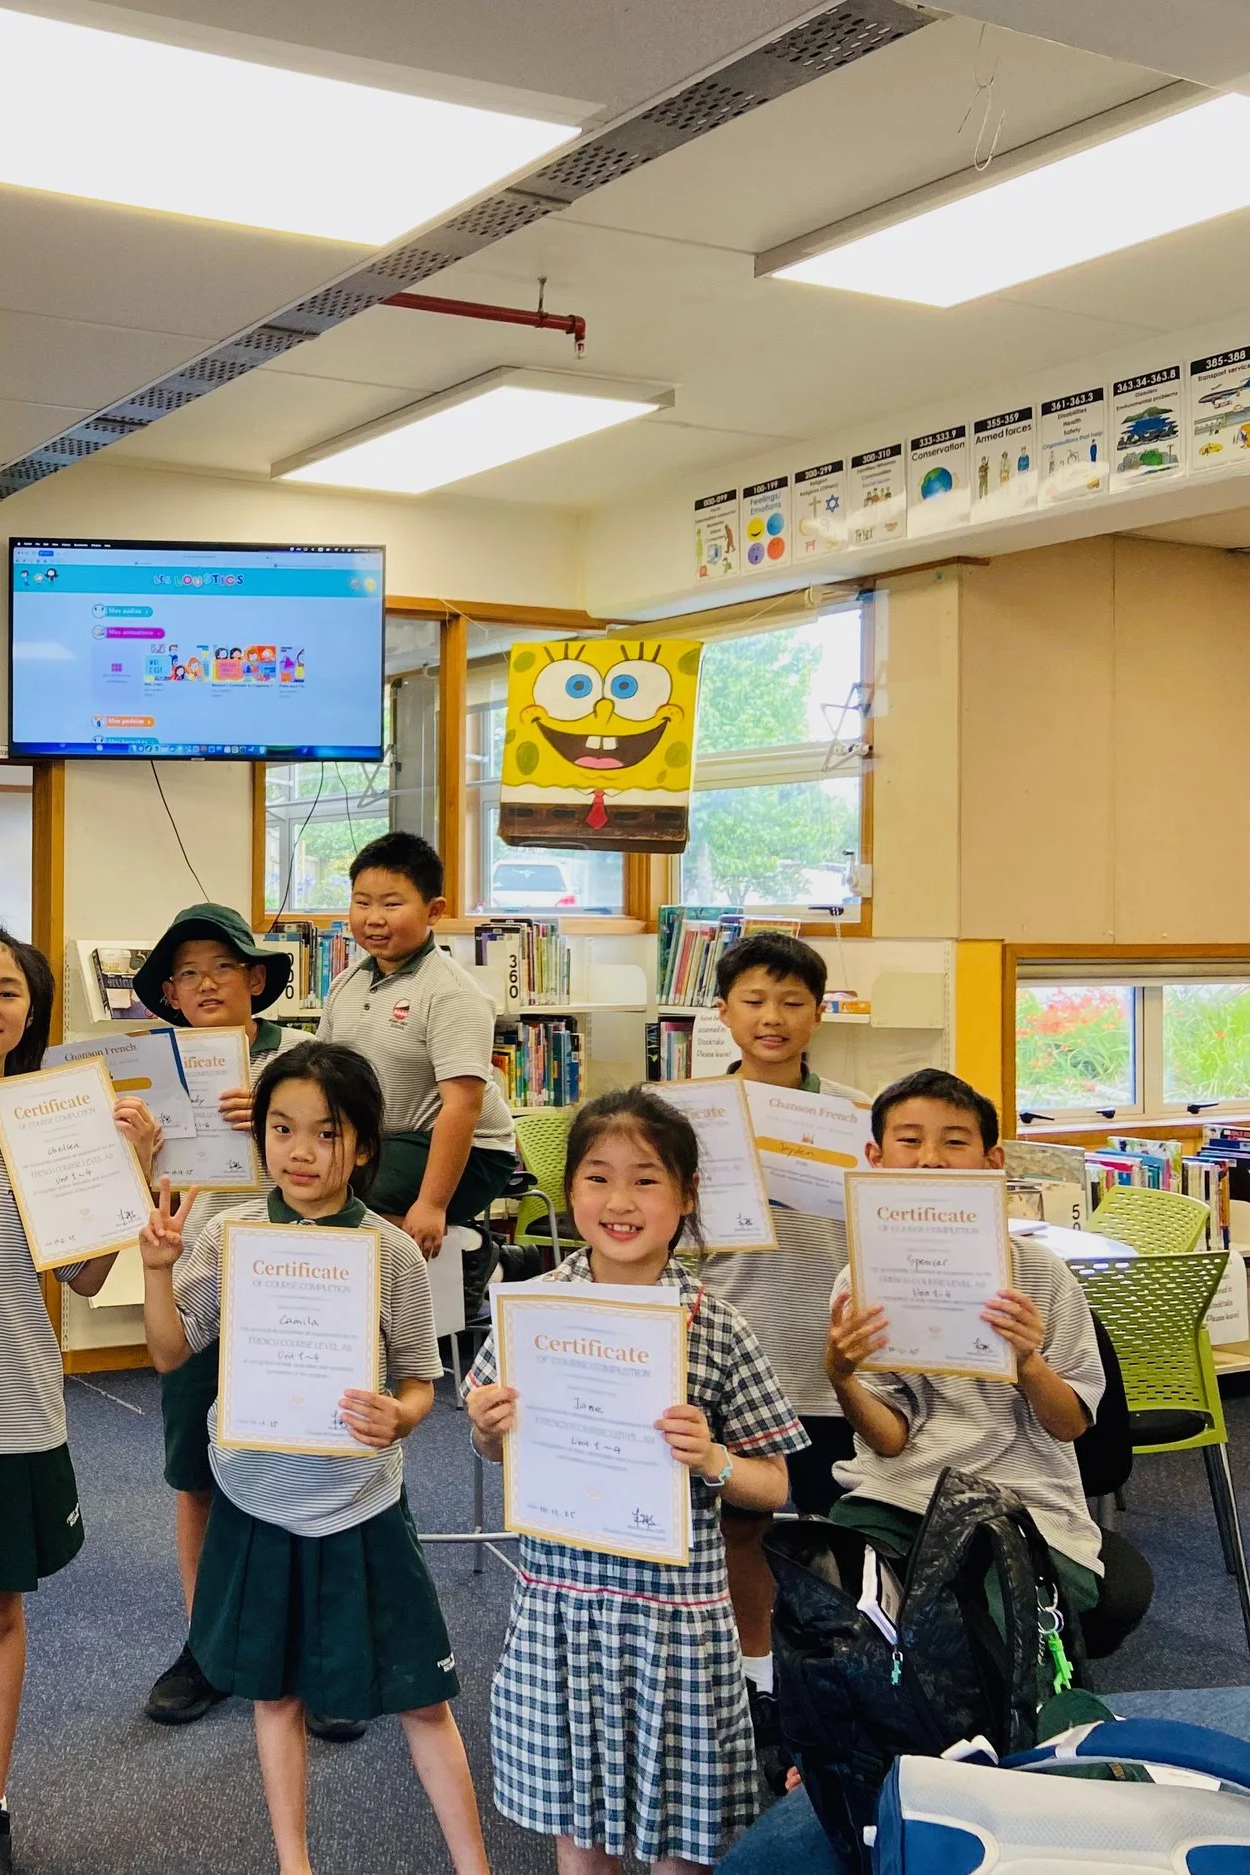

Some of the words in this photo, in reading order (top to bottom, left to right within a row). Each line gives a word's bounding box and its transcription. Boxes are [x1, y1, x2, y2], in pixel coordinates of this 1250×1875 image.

[1205, 350, 1246, 369] 385-388
[1116, 369, 1177, 393] 363.34-363.8
[1050, 392, 1094, 411] 361-363.3
[986, 413, 1020, 429] 355-359
[1063, 418, 1081, 427] Health
[918, 430, 957, 447] 333-333.9
[975, 431, 1004, 445] Armed
[1005, 423, 1032, 439] forces
[1063, 427, 1081, 436] Safety
[862, 449, 891, 464] 300-310
[911, 440, 965, 461] Conservation
[804, 465, 833, 479] 200-299
[753, 482, 778, 494] 100-199
[703, 494, 728, 506] 000-099
[750, 491, 781, 505] Feelings/
[750, 502, 781, 515] Emotions
[174, 573, 244, 588] LOUSTICS
[64, 1047, 104, 1062] Chanson
[105, 1043, 137, 1056] French
[13, 1094, 91, 1121] Certificate
[769, 1098, 817, 1116] Chanson
[819, 1107, 858, 1124] French
[877, 1206, 977, 1223] Certificate
[252, 1260, 350, 1281] Certificate
[265, 1281, 298, 1289] COURSE
[300, 1283, 351, 1293] COMPLETION
[279, 1313, 319, 1327] Camila
[534, 1334, 650, 1364] Certificate
